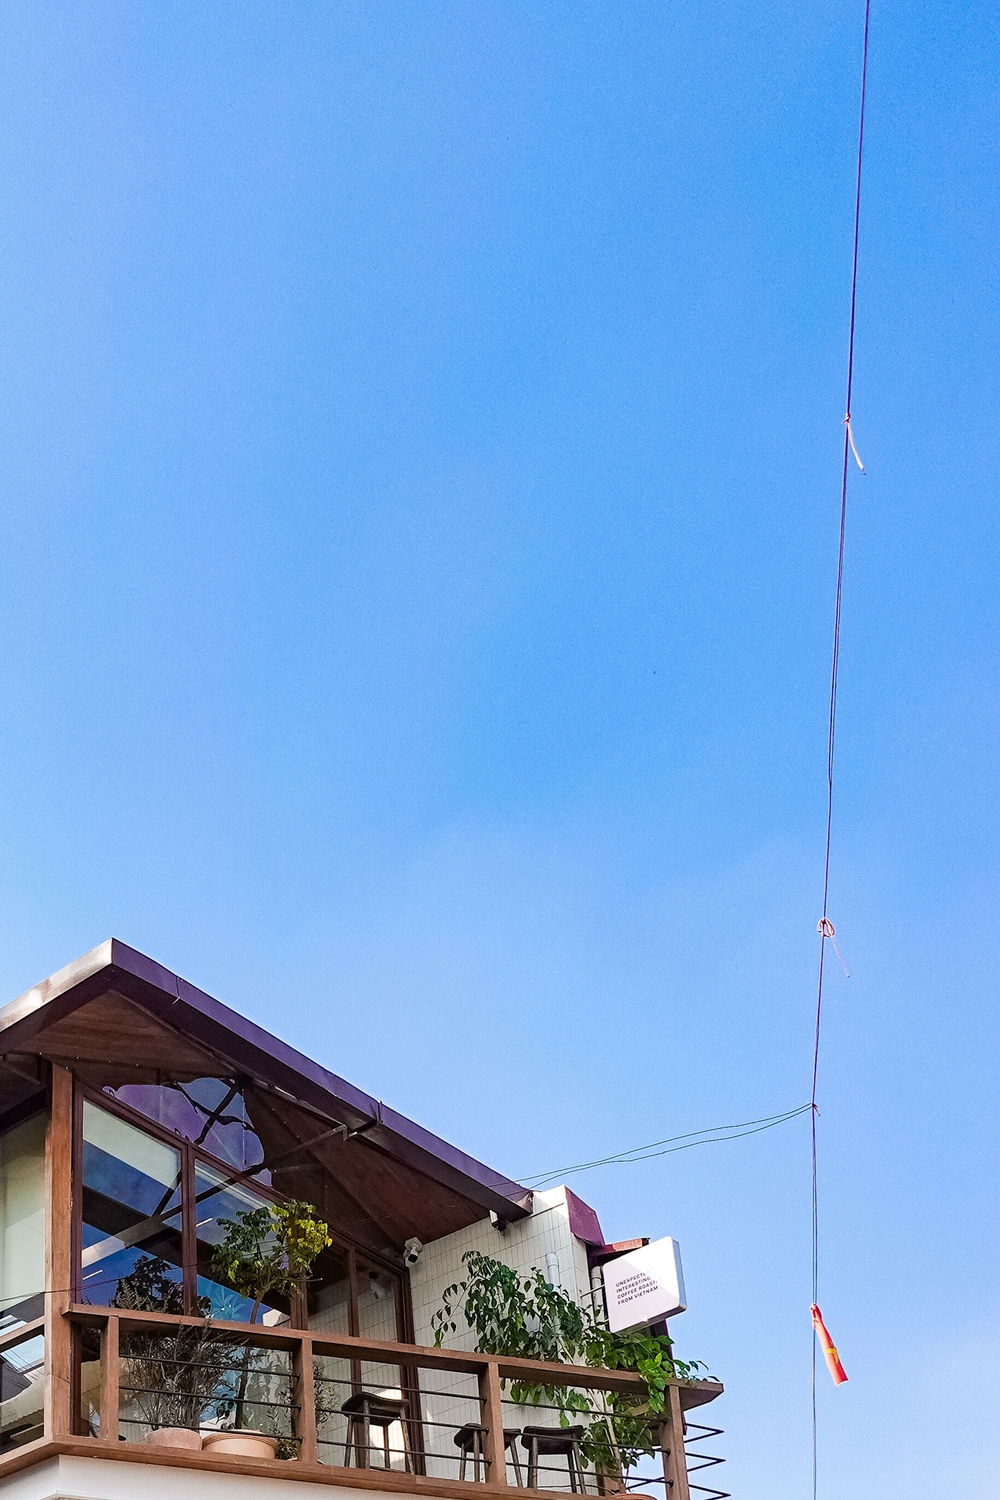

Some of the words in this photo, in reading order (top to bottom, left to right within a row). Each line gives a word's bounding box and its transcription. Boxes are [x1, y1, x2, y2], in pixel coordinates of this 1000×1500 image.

[616, 1276, 651, 1293] INTERESTING
[617, 1287, 638, 1299] COFFEE
[617, 1296, 634, 1305] FROM
[634, 1285, 659, 1299] VIETNAM
